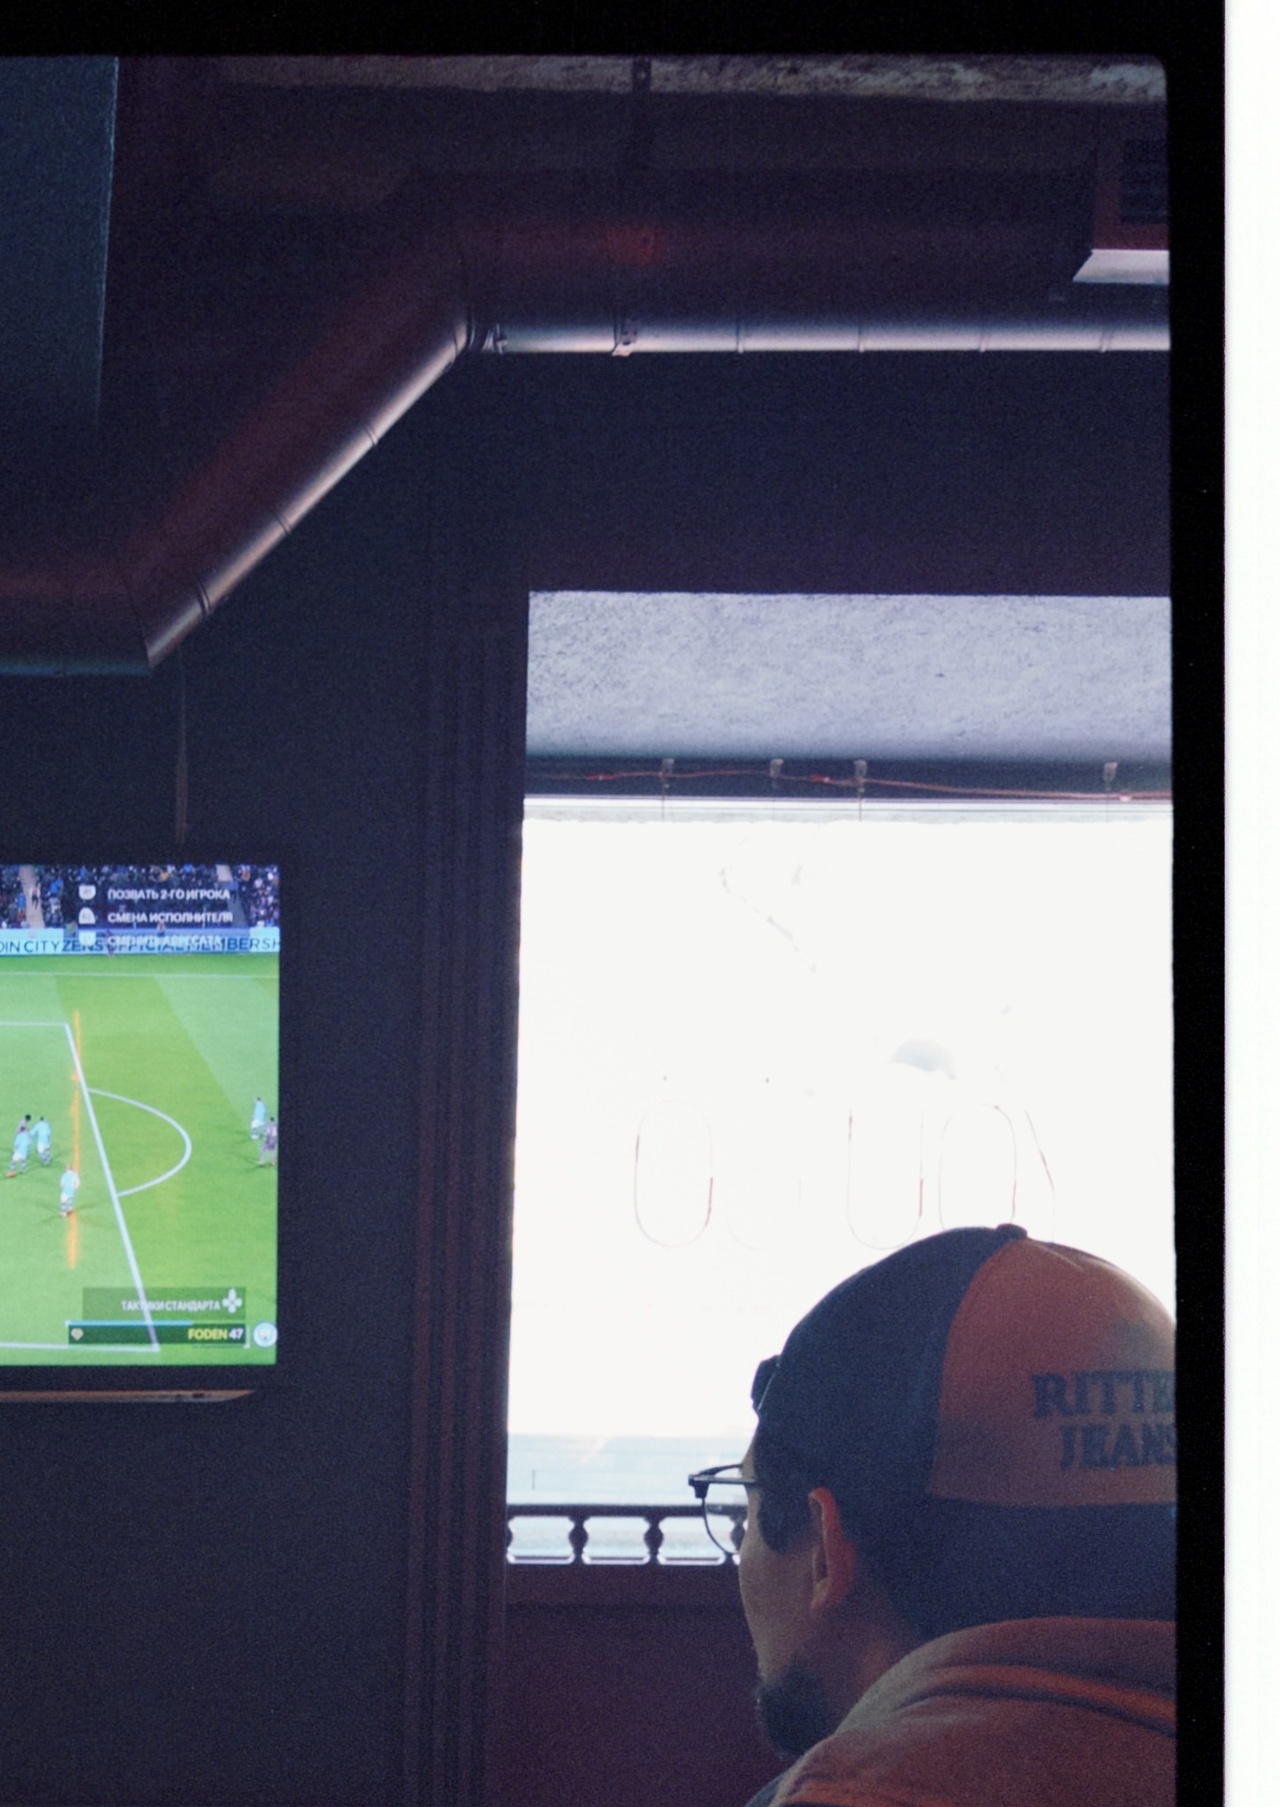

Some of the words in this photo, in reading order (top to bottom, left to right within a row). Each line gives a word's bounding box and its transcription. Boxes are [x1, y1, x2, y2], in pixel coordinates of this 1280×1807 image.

[107, 888, 159, 901] ПОЗВАТЬ
[186, 888, 231, 901] ИГРОКА
[107, 911, 148, 924] СМЕНА
[149, 911, 233, 924] ИСПОЛНИТЕЛЯ
[187, 1328, 228, 1340] FODEN
[228, 1328, 244, 1340] 47
